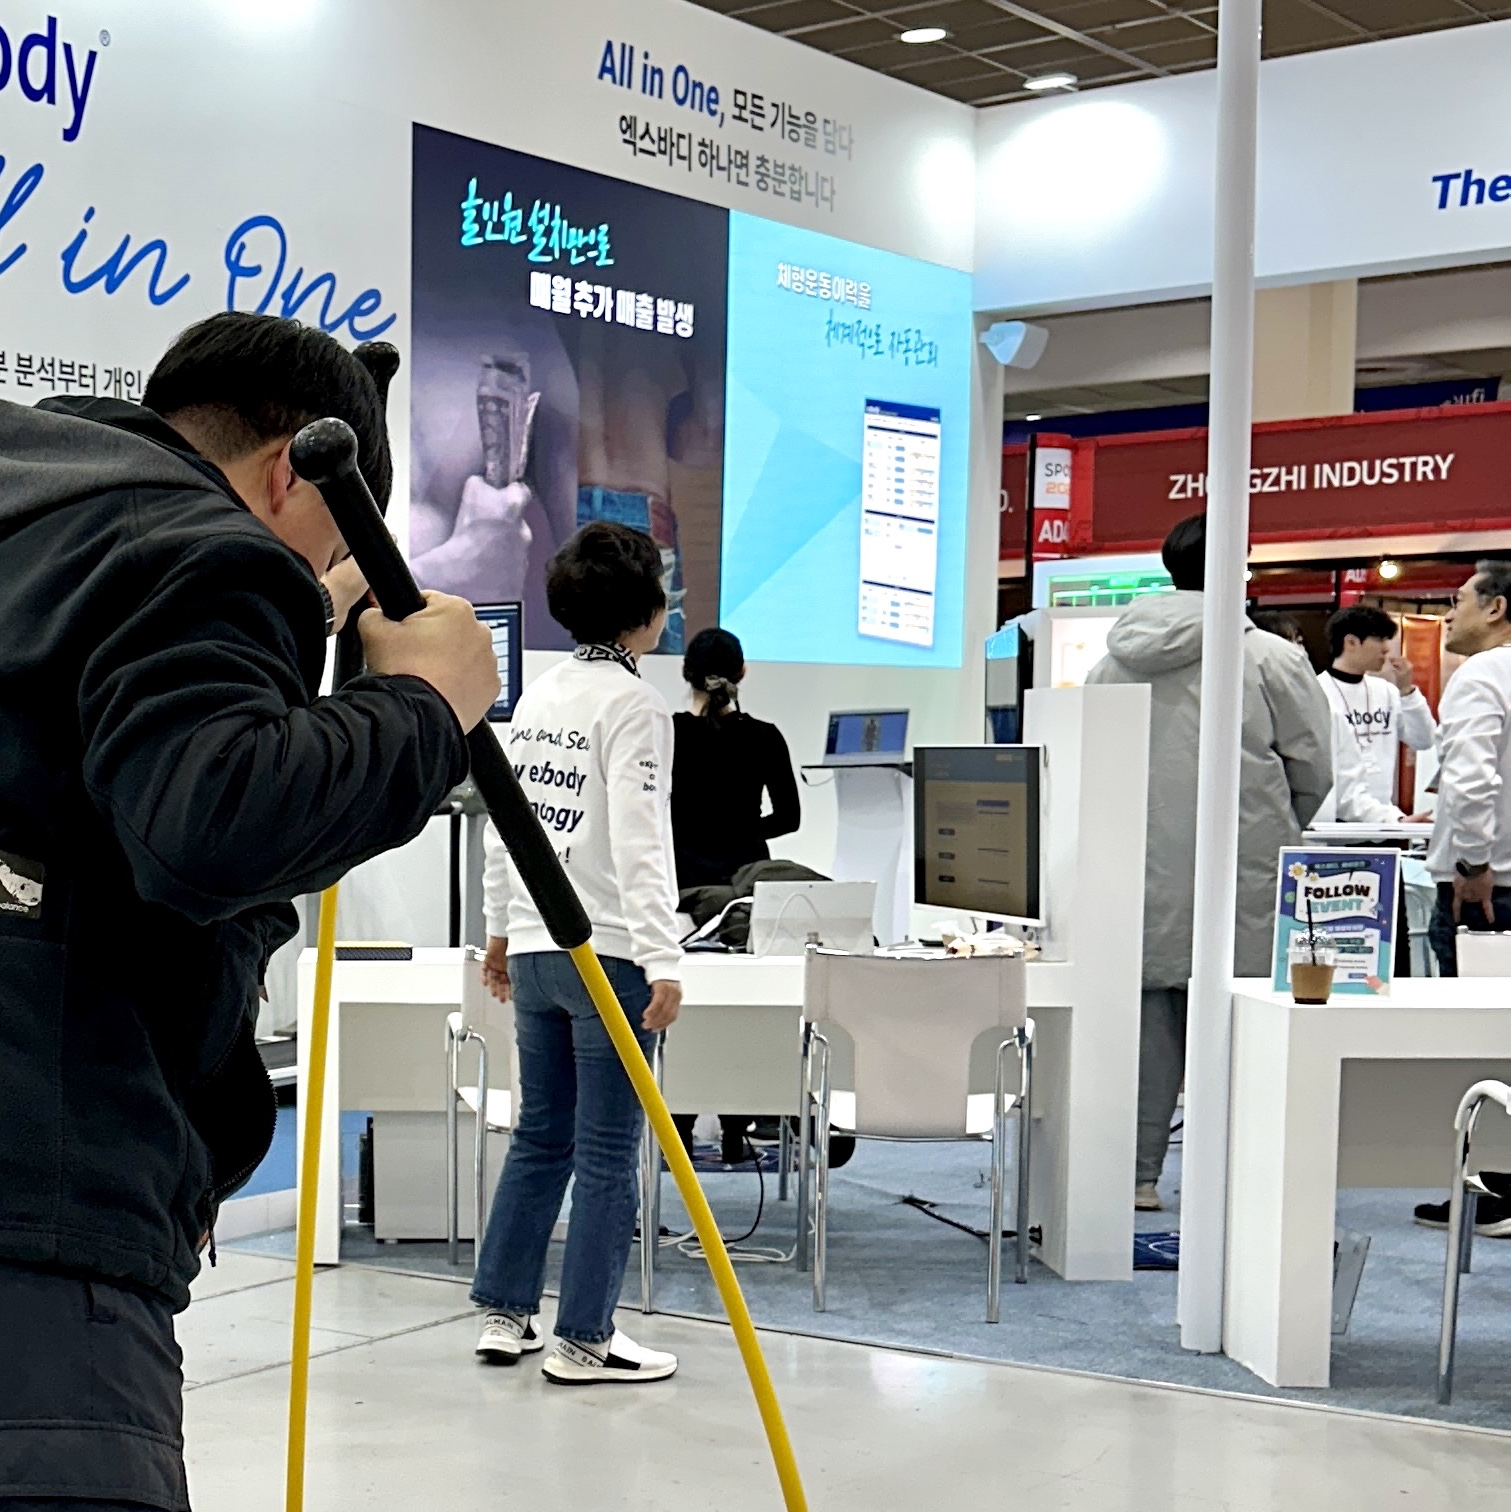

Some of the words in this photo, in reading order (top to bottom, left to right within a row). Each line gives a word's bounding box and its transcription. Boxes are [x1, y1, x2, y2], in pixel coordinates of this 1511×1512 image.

[598, 39, 634, 90] All
[641, 51, 664, 100] in
[671, 64, 725, 128] One,
[732, 88, 766, 132] 모든
[770, 102, 818, 150] 기능을
[822, 117, 854, 160] 담다
[619, 114, 693, 172] 엑스바디
[698, 137, 750, 187] 하나면
[754, 154, 836, 213] 충분합니다
[61, 206, 190, 306] in
[225, 215, 397, 341] One
[574, 280, 614, 323] 추가
[616, 289, 654, 331] 매출
[656, 297, 694, 339] 발생
[14, 352, 97, 396] 분석부터
[1168, 464, 1307, 500] ZHGZHI
[1313, 453, 1455, 489] INDUSTRY
[1304, 884, 1371, 899] FOLLOW
[1309, 898, 1364, 914] EVENT
